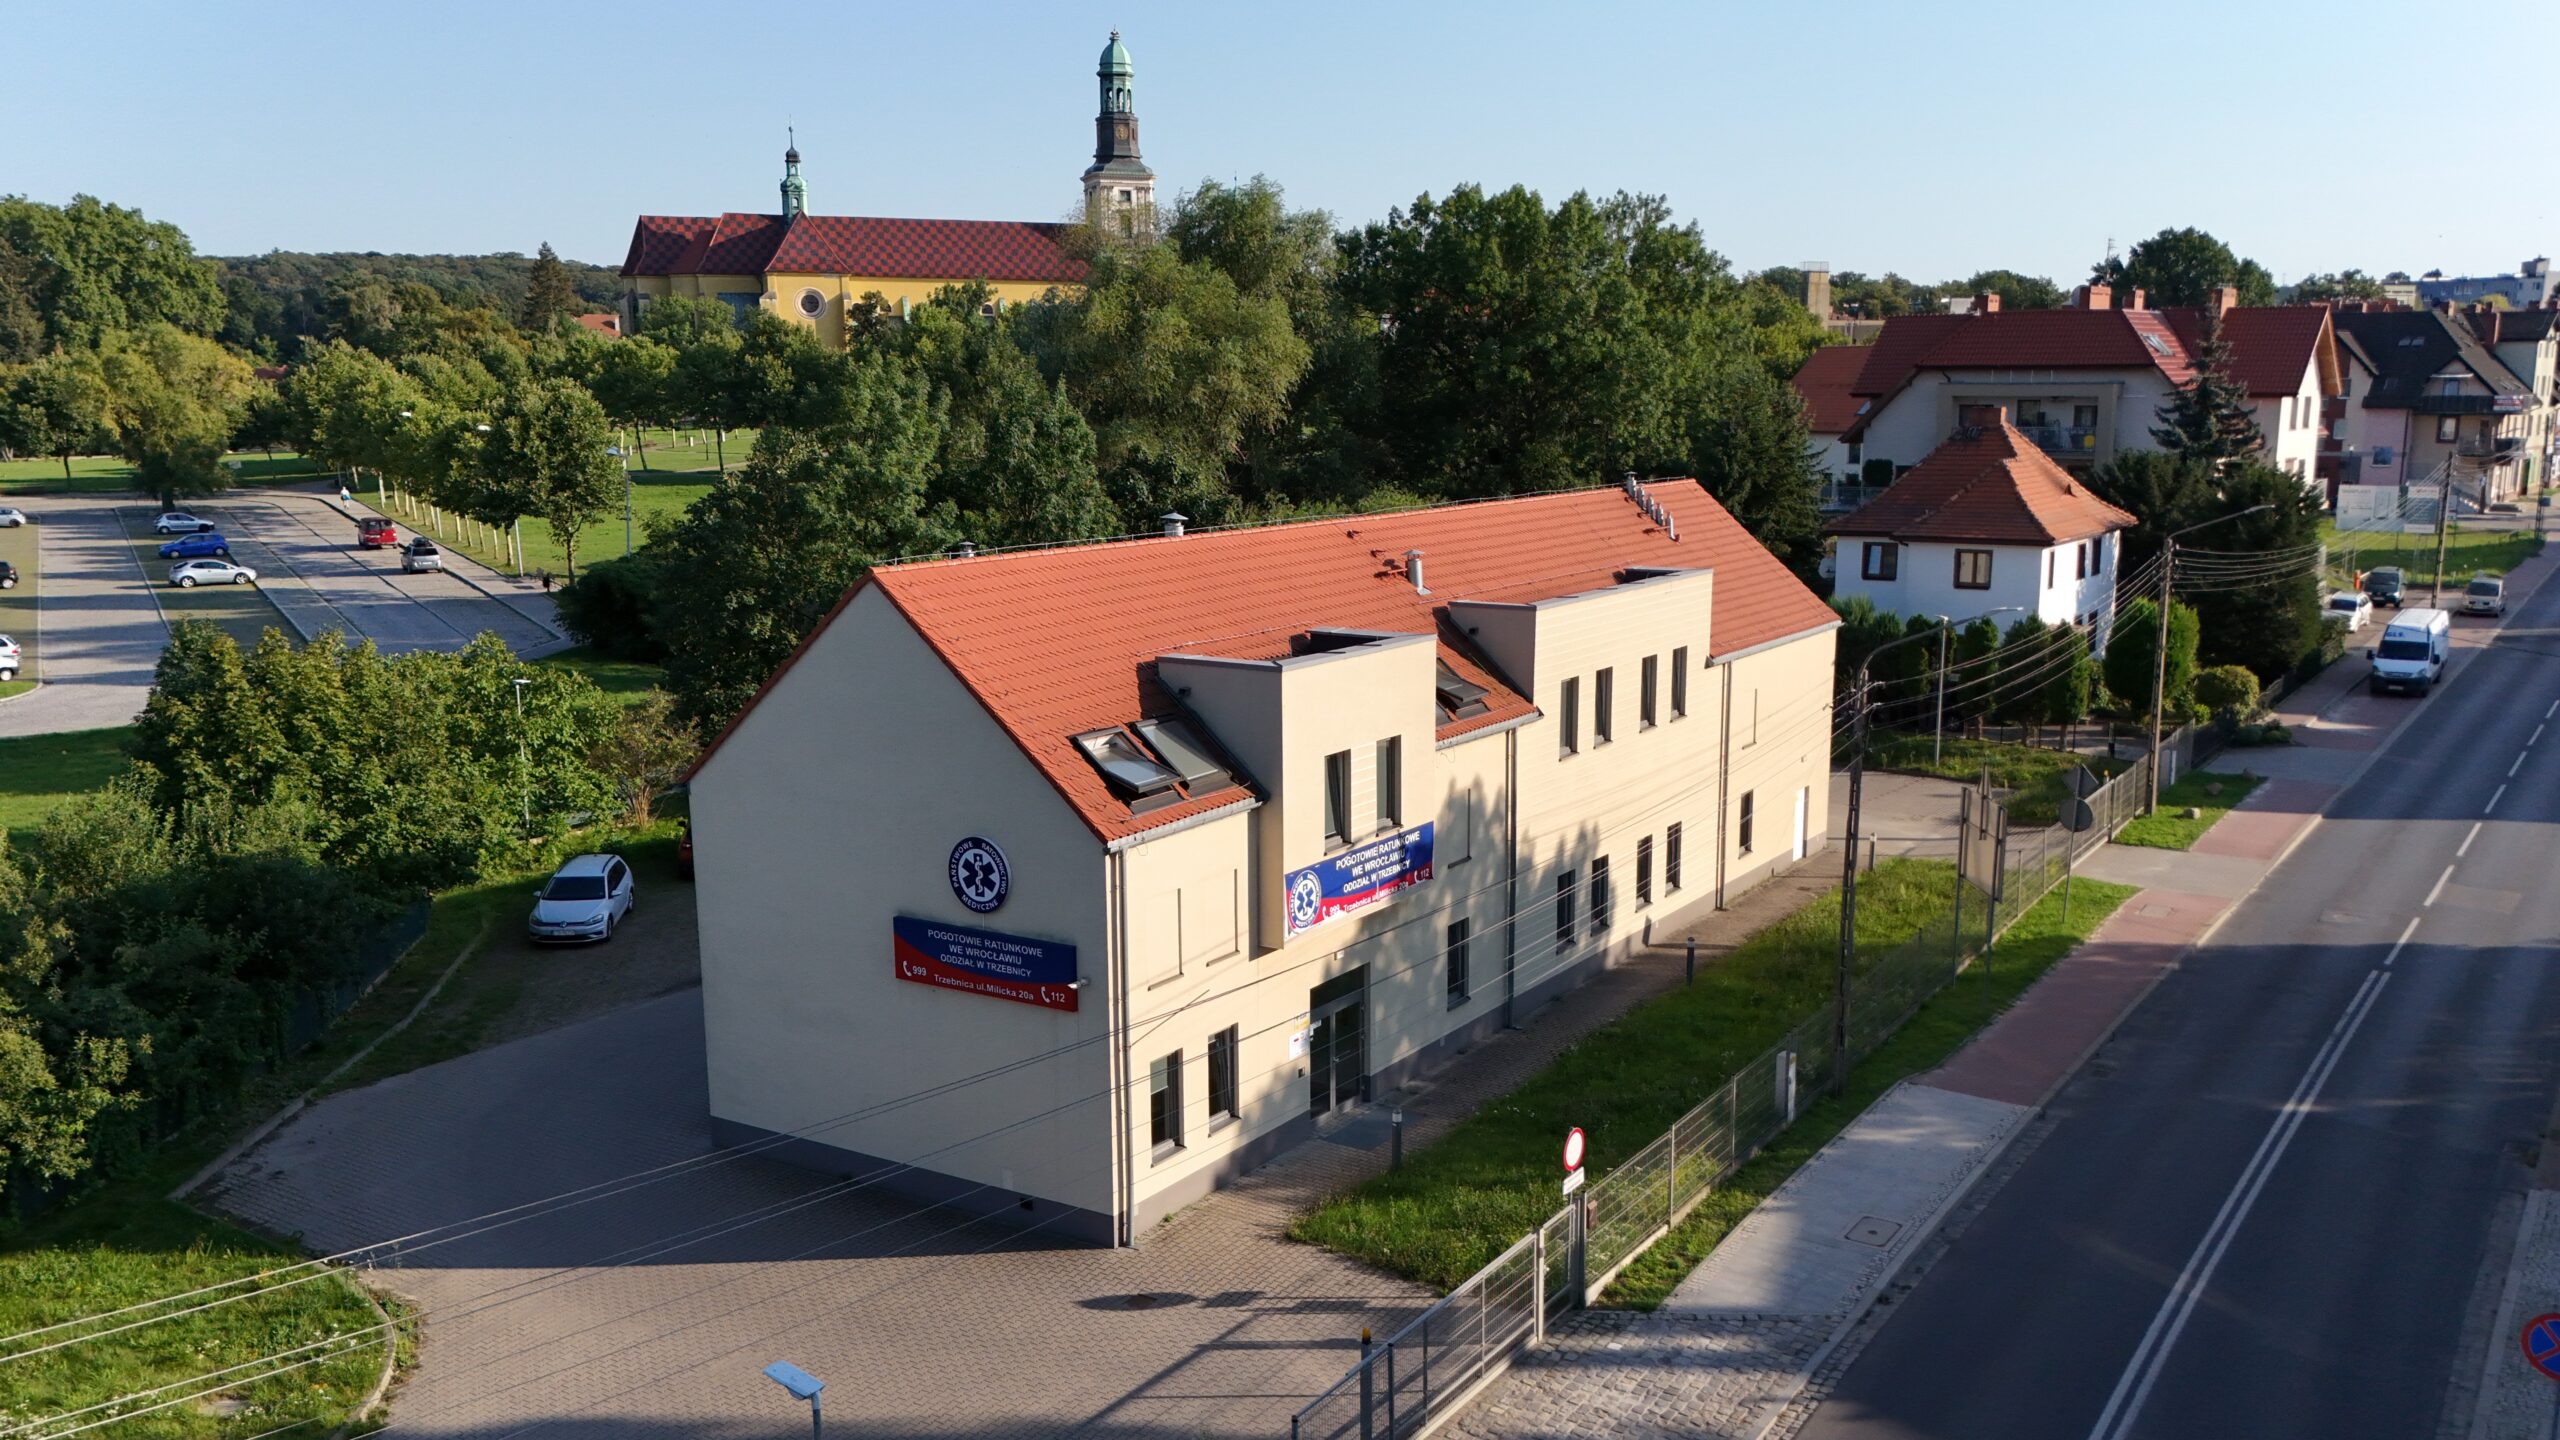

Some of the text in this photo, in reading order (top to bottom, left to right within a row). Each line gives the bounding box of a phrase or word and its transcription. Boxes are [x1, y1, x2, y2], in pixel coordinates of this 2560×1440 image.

[1336, 831, 1420, 870] POGOTOWIE RATUNKOWE
[1352, 849, 1405, 877] WE WROCŁAWIU
[981, 842, 1007, 894] RATOWNICTWO
[1343, 860, 1410, 893] ODDZIAŁ W TRZEBNICY
[961, 894, 998, 911] MEDYCZNE
[1344, 896, 1371, 912] Trzebnica
[1420, 868, 1430, 878] 112
[928, 929, 1043, 957] POGOTOWIE RATUNKOWE
[949, 944, 1022, 965] WE WROCŁAWIU
[940, 954, 974, 967] ODDZIAŁ
[977, 960, 984, 968] W
[912, 966, 927, 976] 999
[934, 974, 974, 988] Trzebnica
[1018, 990, 1034, 1000] 20a
[1051, 992, 1066, 1002] 112
